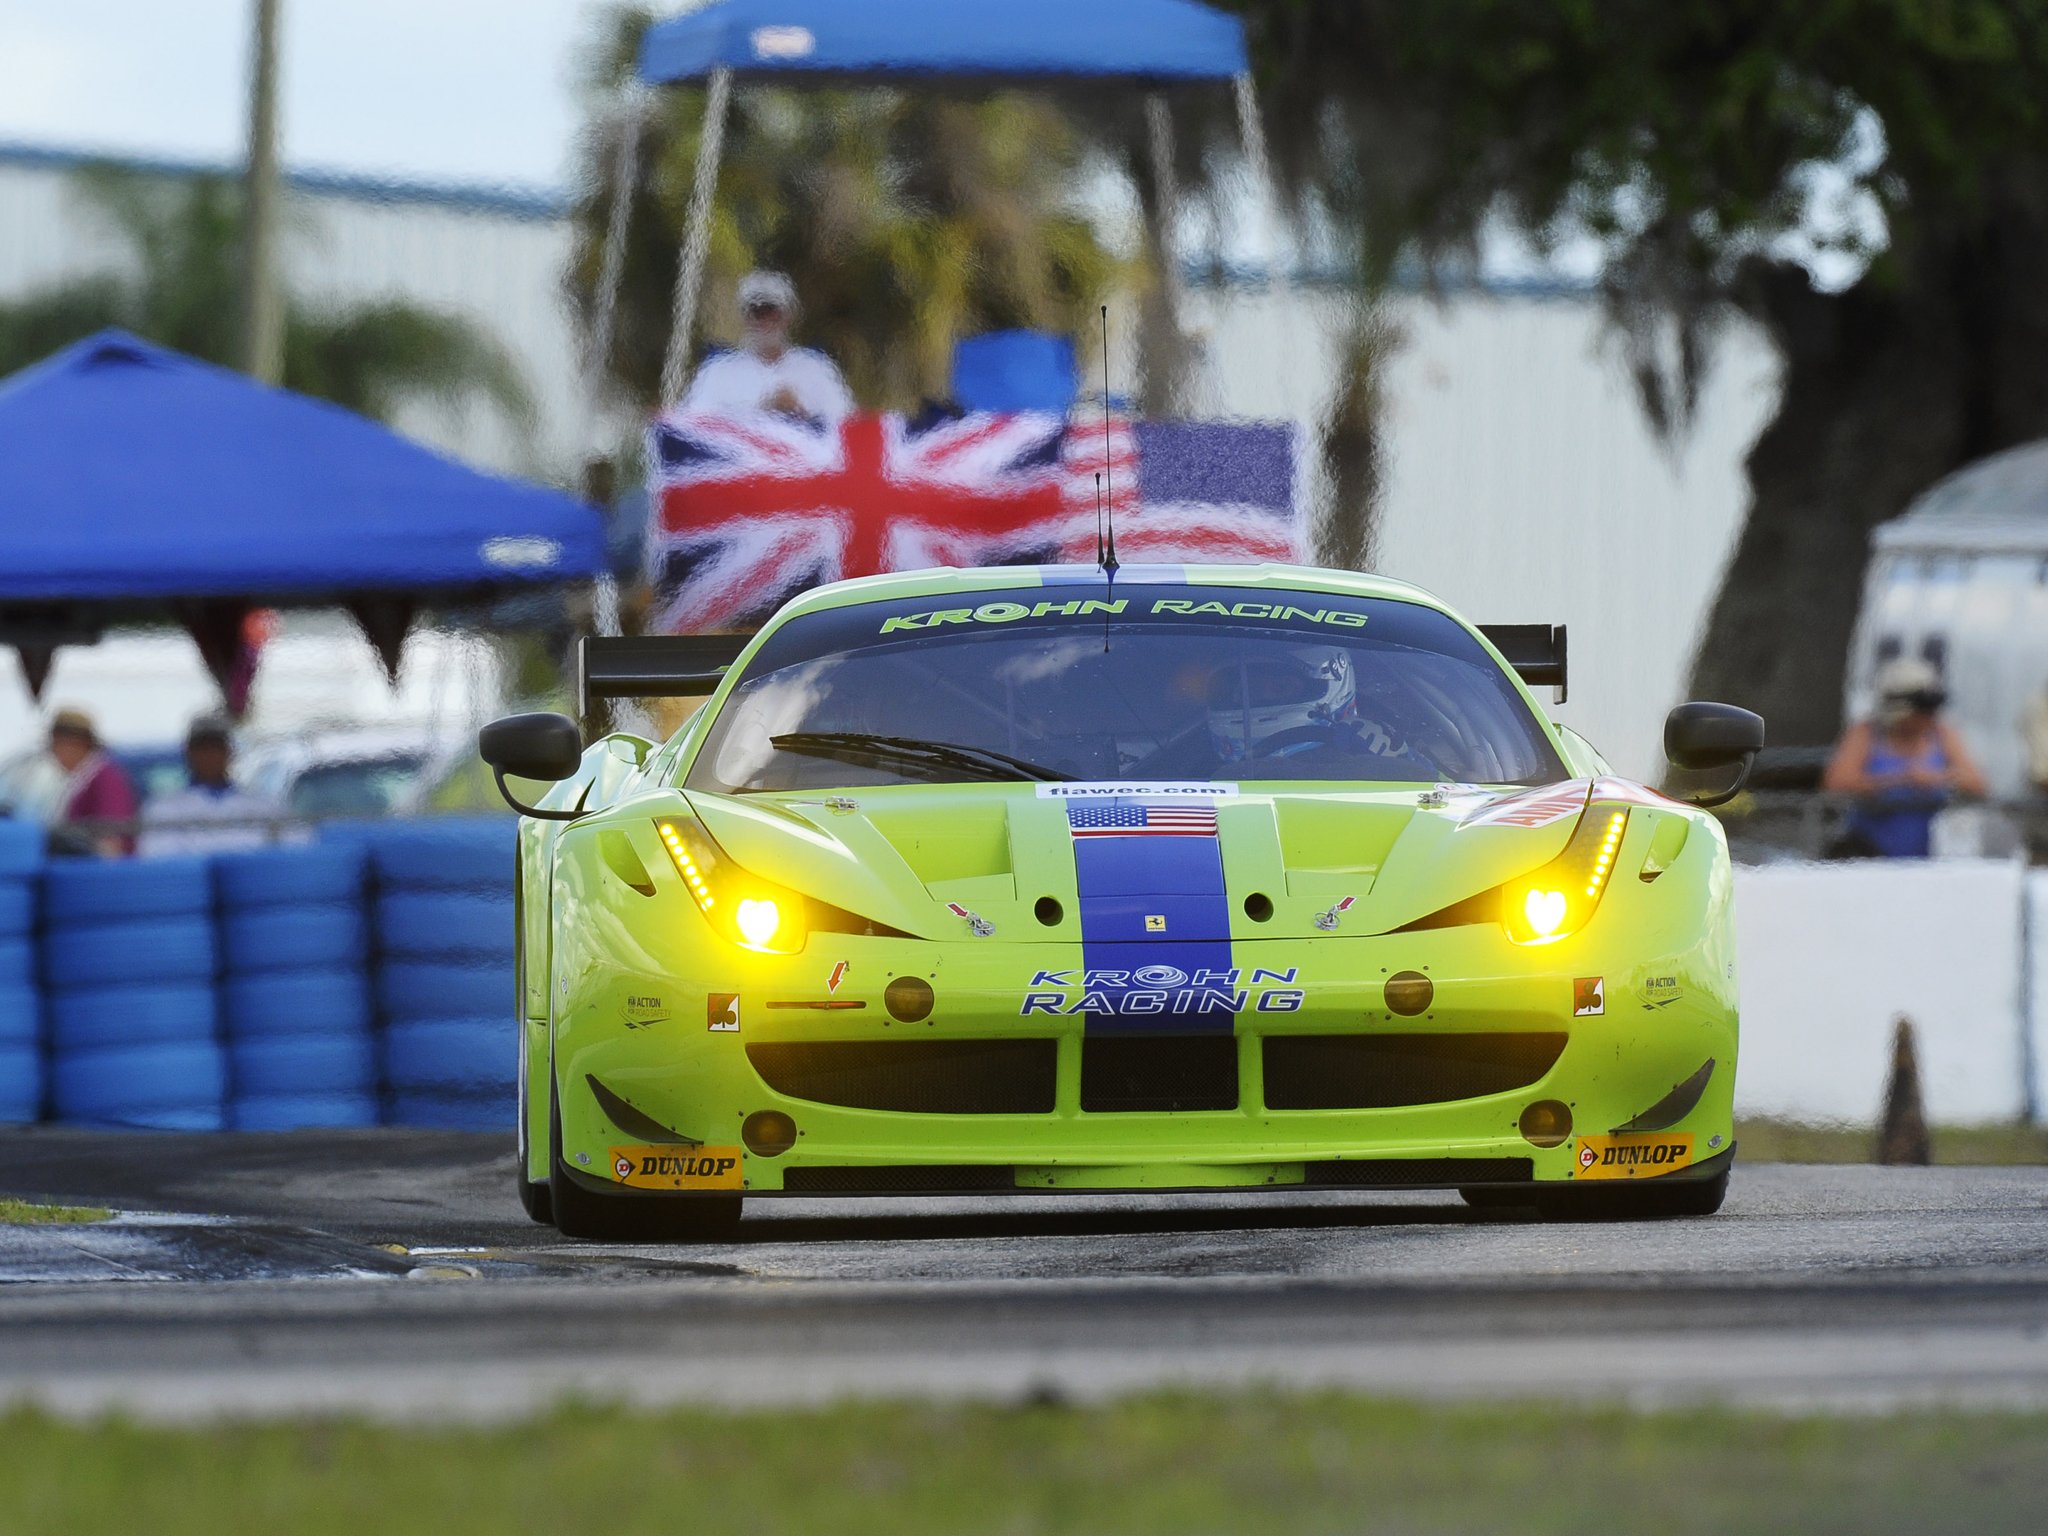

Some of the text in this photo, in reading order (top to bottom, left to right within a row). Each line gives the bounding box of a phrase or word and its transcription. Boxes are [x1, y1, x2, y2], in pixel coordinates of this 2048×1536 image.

[879, 599, 1369, 634] KROHN RACING
[1049, 787, 1227, 796] fiawec.com
[1028, 964, 1299, 989] KROHN
[1655, 976, 1676, 988] ACTION
[636, 997, 661, 1008] ACTION
[1019, 988, 1306, 1016] RACING
[1601, 1145, 1687, 1165] DUNLOP
[640, 1157, 736, 1176] DUNLOP
